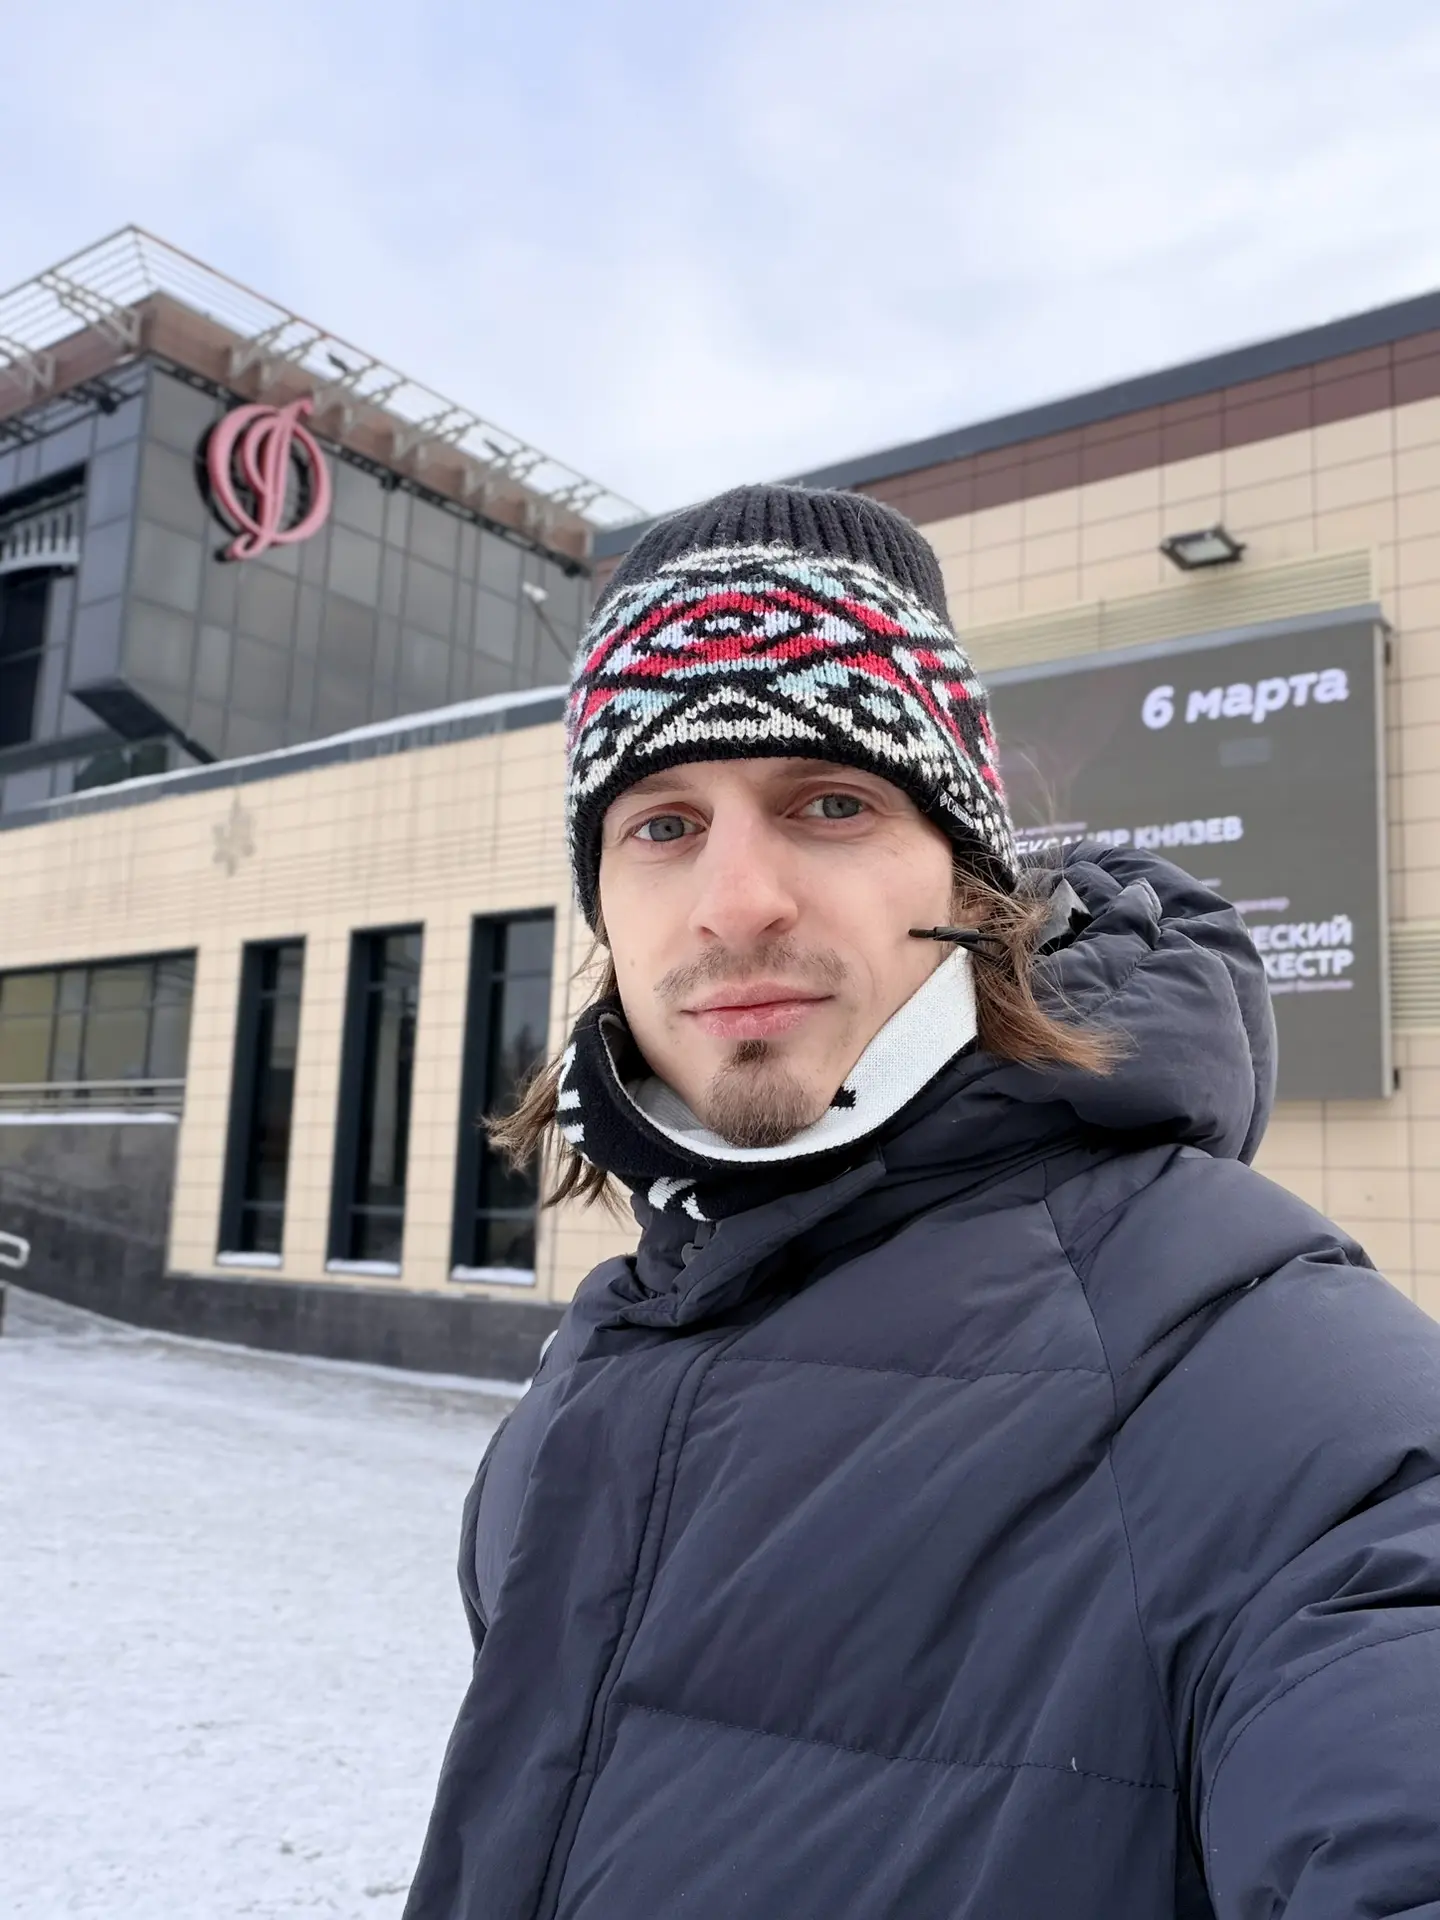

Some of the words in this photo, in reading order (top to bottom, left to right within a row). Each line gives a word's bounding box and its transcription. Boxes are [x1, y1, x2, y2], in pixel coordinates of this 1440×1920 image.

[1142, 685, 1175, 730] 6
[1185, 668, 1349, 723] марта
[1134, 816, 1243, 849] КНЯЗЕВ
[1247, 914, 1353, 951] ЕСКИЙ
[1261, 949, 1354, 978] КЕСТР
